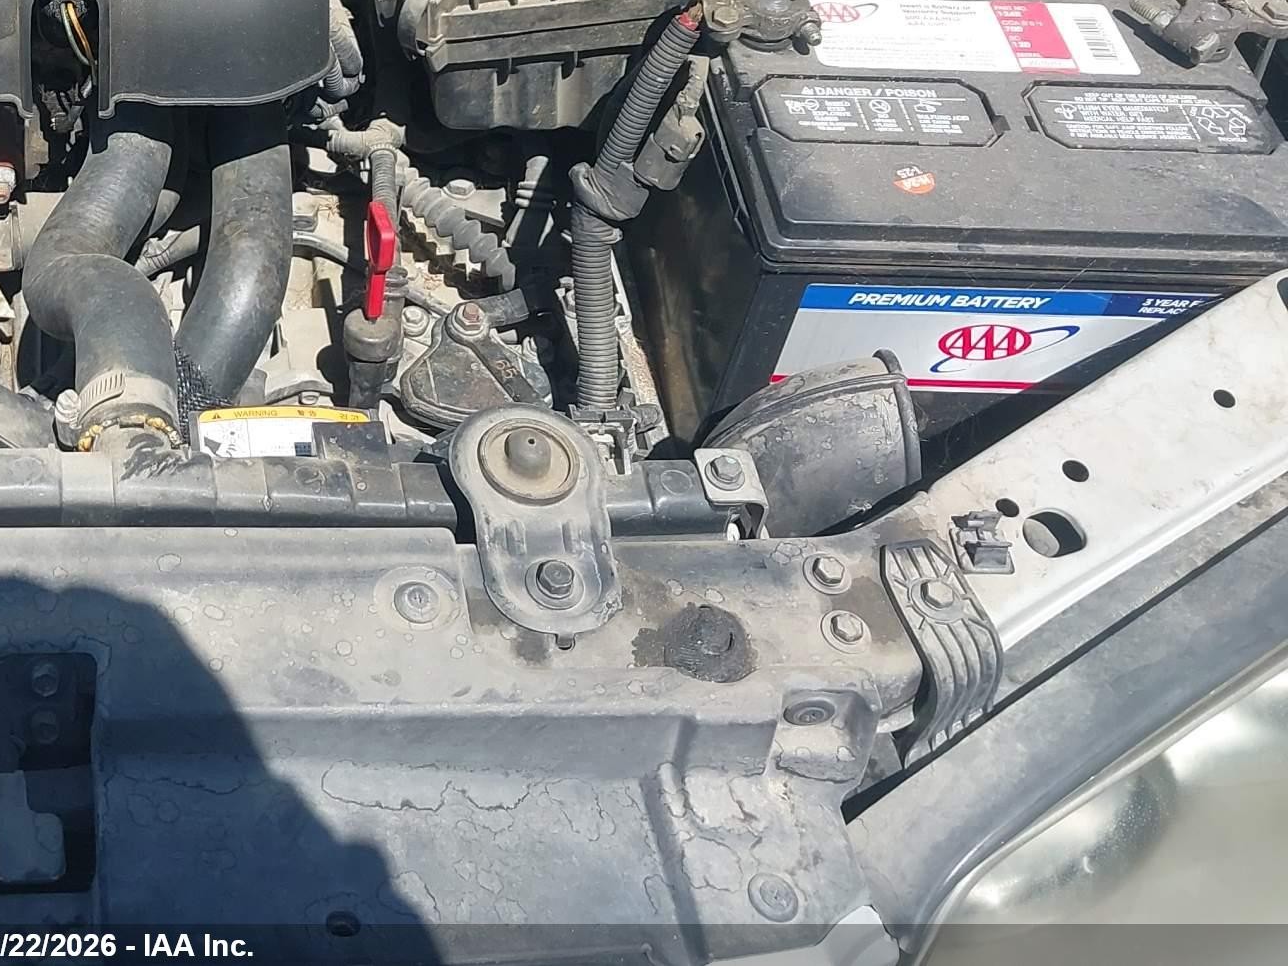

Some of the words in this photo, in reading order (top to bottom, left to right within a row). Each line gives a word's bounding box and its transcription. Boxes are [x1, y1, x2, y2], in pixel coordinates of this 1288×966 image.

[812, 1, 861, 24] AAA
[814, 86, 873, 97] DANGER
[885, 88, 937, 99] POISON
[1077, 104, 1101, 112] FLUSH
[1121, 105, 1169, 114] IMMEDIATELY
[847, 292, 954, 308] PREMIUM
[954, 294, 1052, 310] BATTERY
[1141, 298, 1154, 306] 3
[1154, 299, 1189, 308] YEAR
[1137, 306, 1188, 315] REPLAC
[939, 324, 1032, 361] AAA
[233, 409, 278, 418] WARNING
